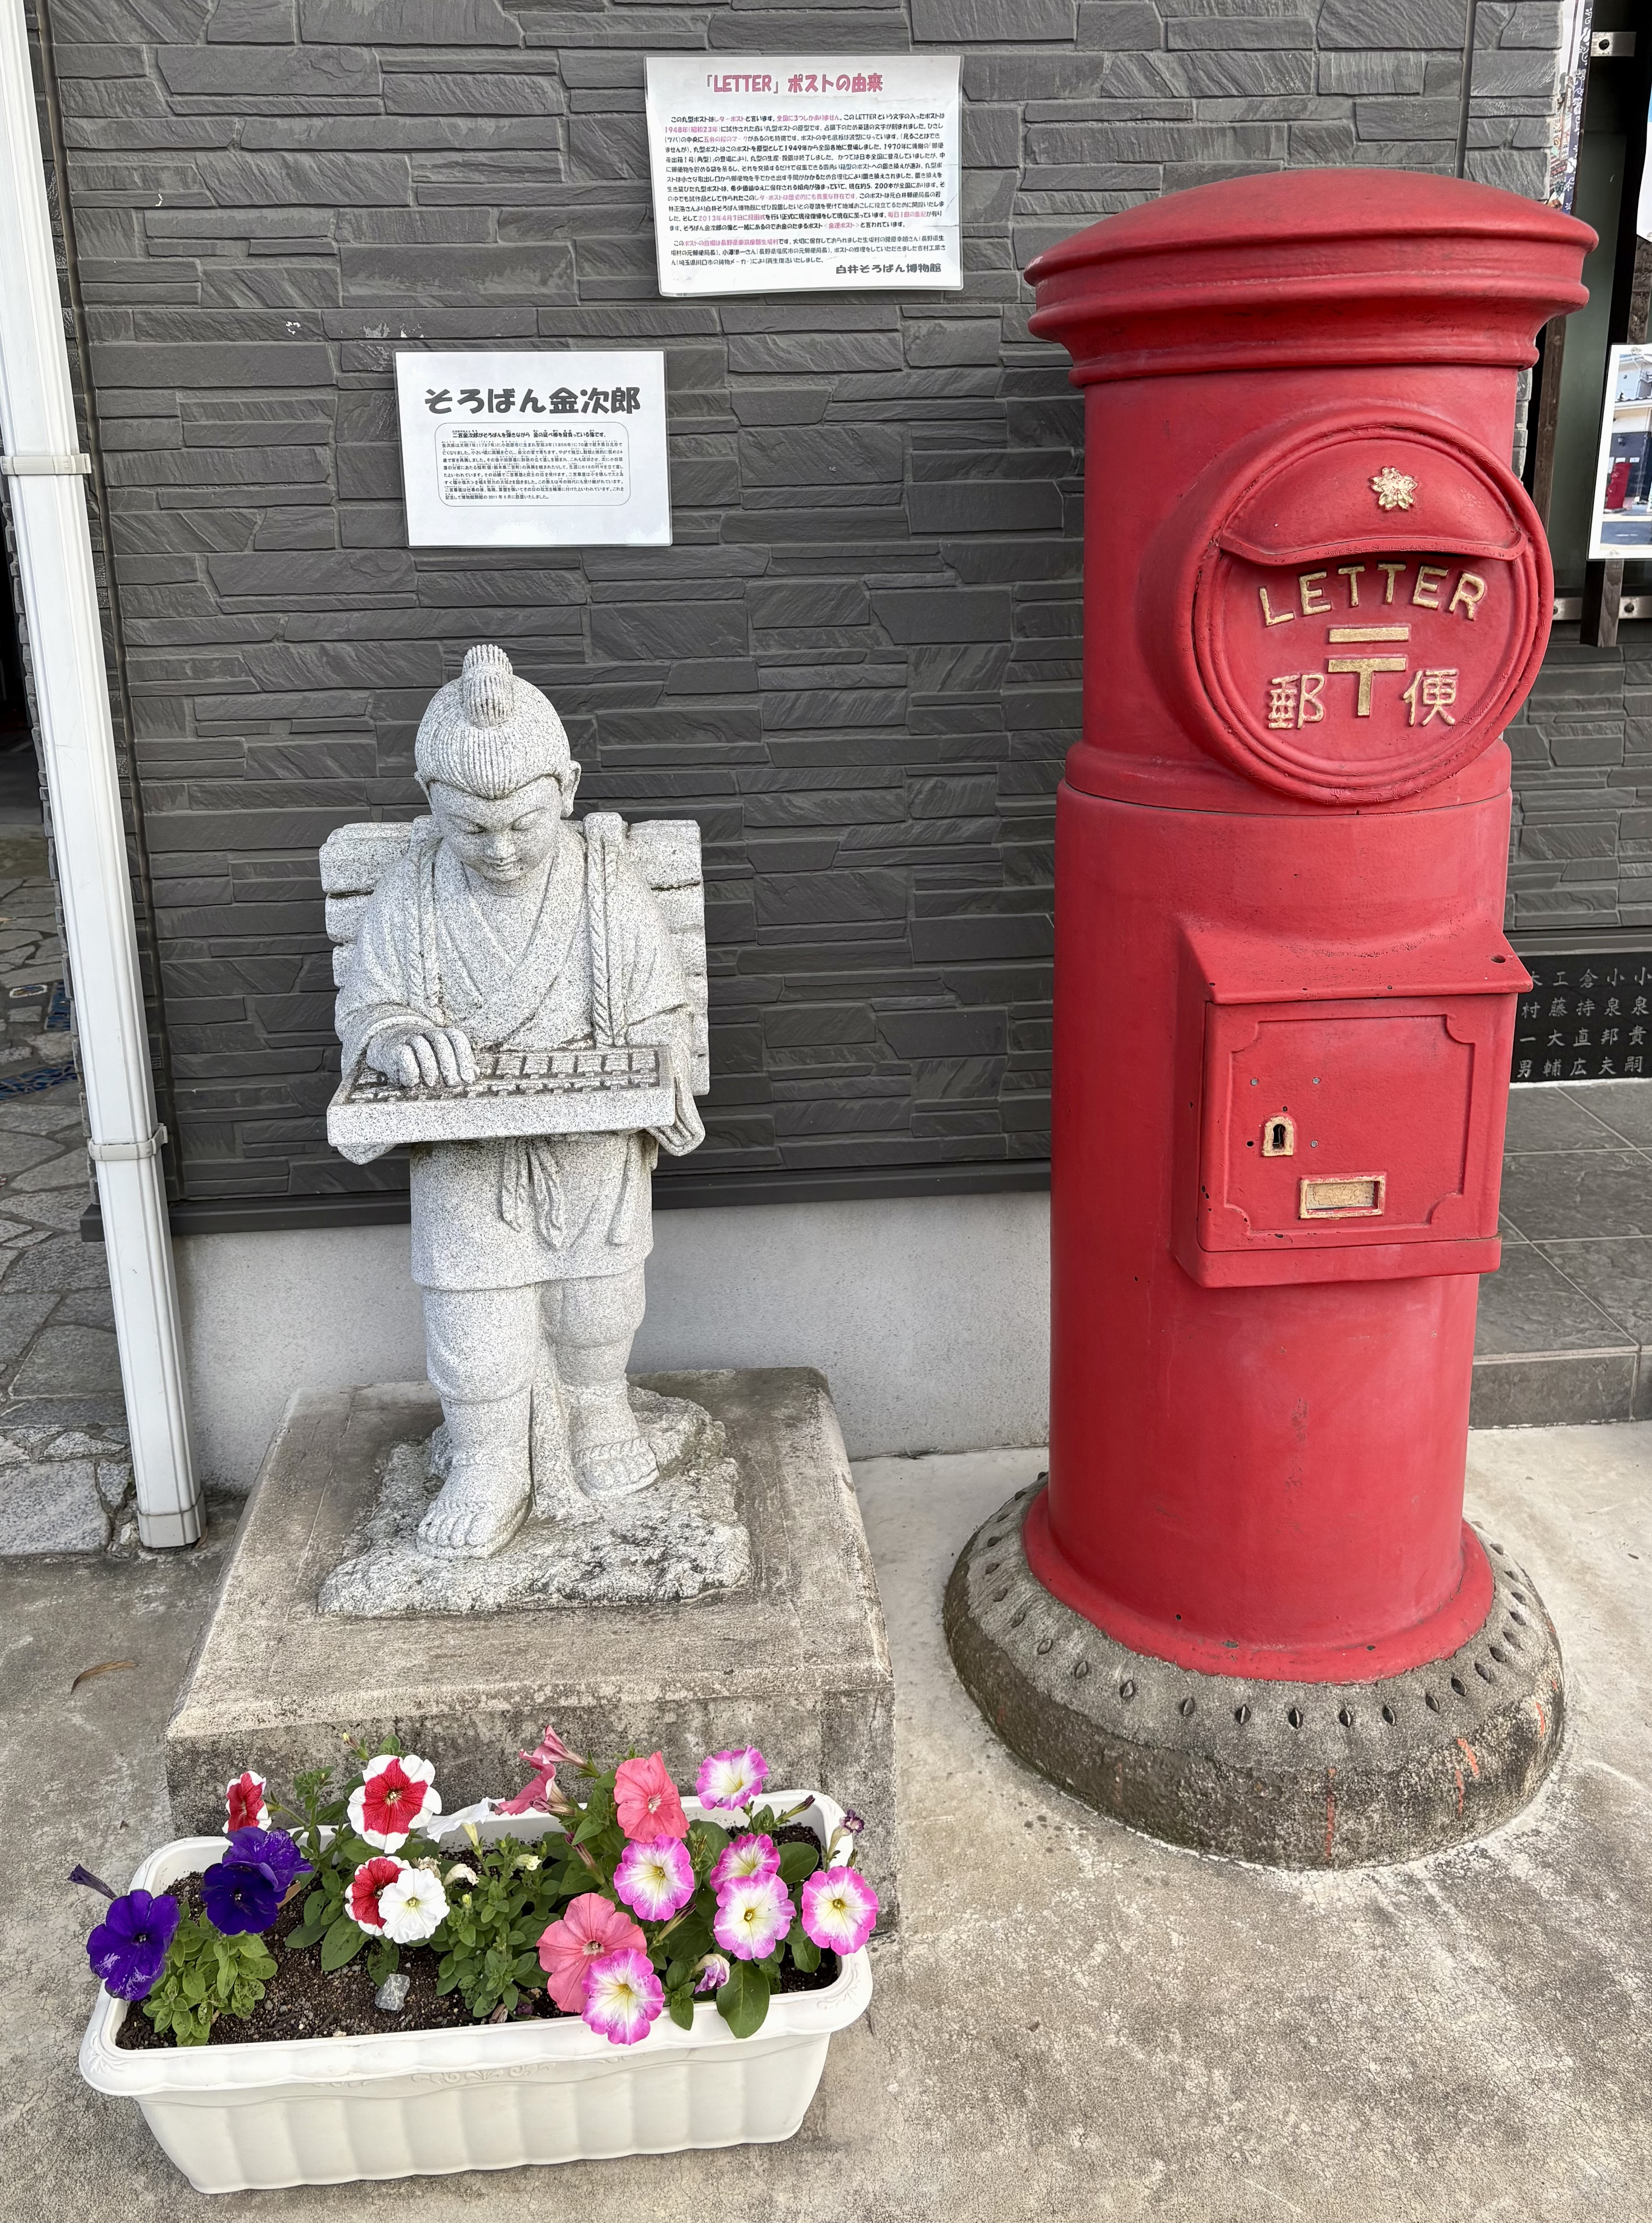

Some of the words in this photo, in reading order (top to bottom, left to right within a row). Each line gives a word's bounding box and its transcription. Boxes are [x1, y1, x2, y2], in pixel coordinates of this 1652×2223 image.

[707, 73, 883, 94] 「LETTER」ポストの由来
[836, 263, 941, 274] 白井そろばん博物館
[425, 387, 640, 414] そろばん金次郎
[1260, 563, 1485, 627] LETTER
[1543, 971, 1568, 1077] 工藤大輔
[1570, 968, 1598, 1076] 倉持直広
[1598, 968, 1625, 1075] 小泉邦夫
